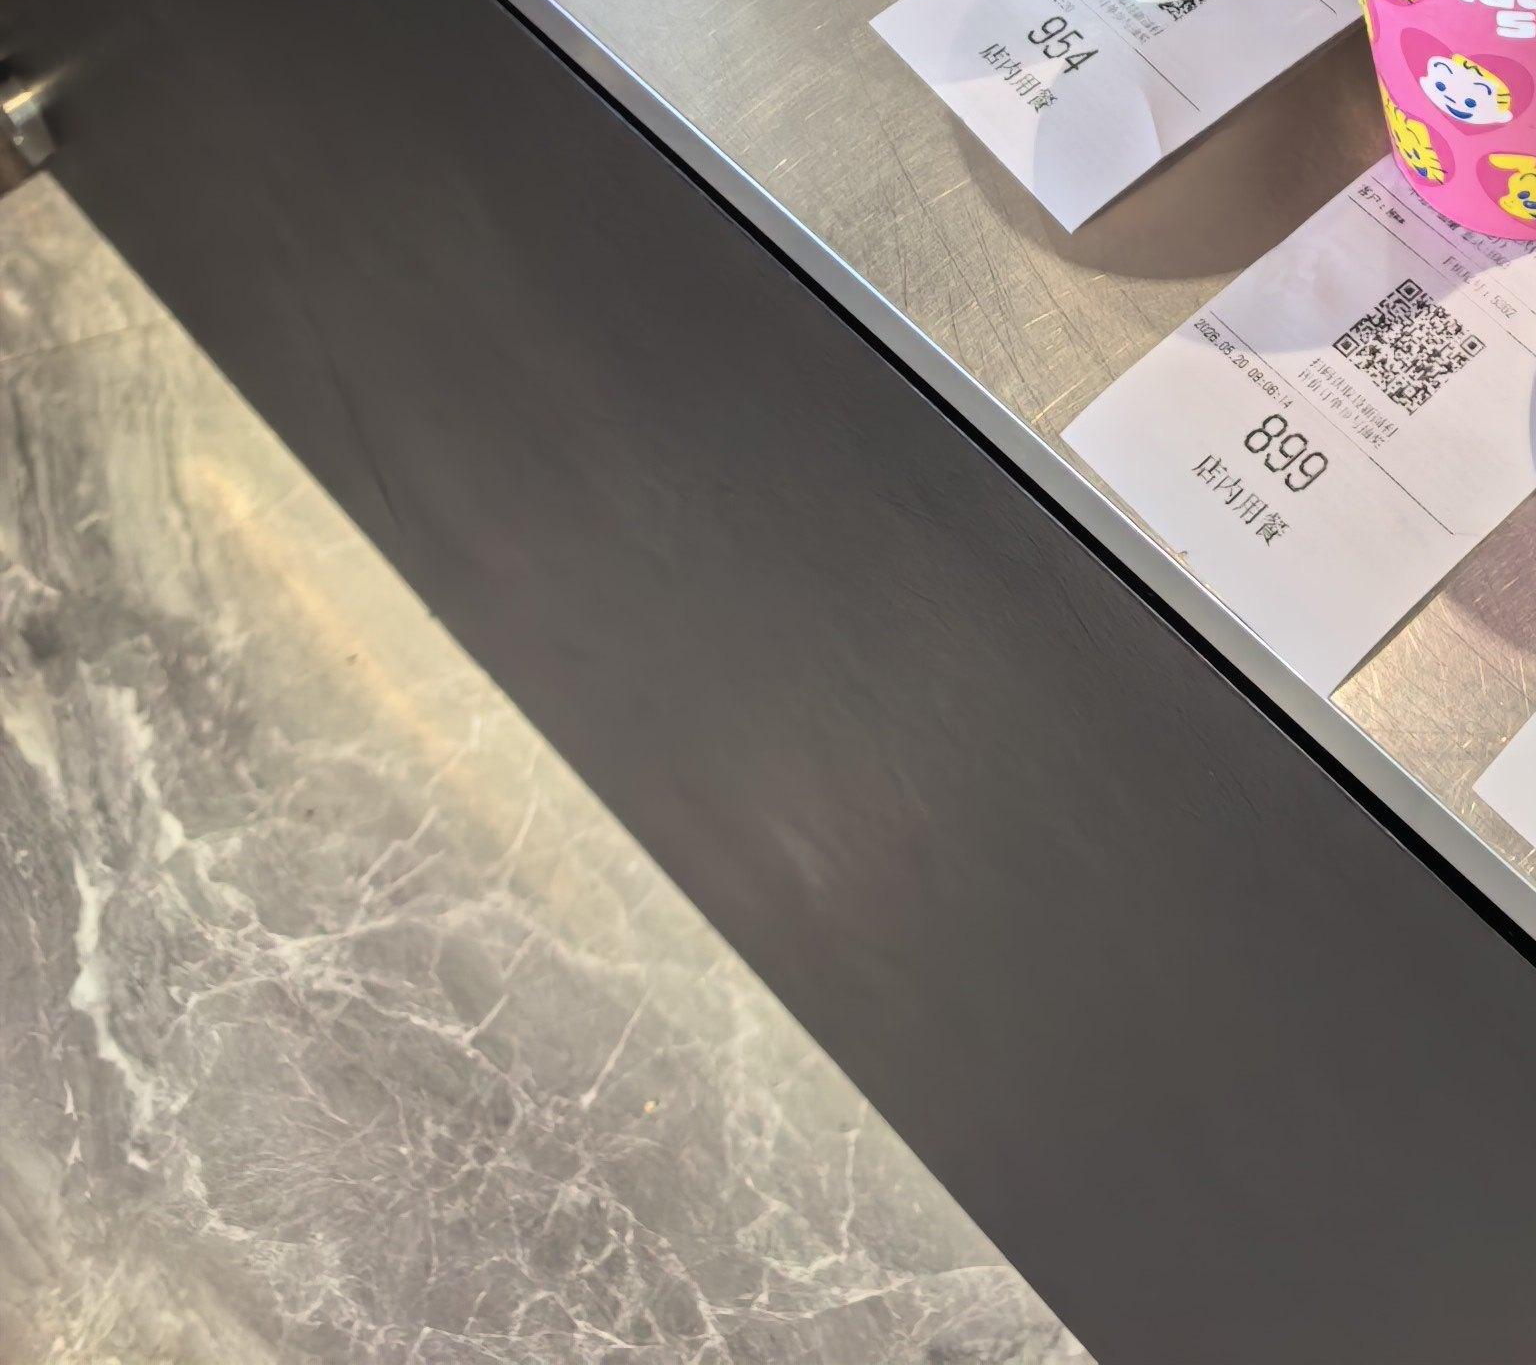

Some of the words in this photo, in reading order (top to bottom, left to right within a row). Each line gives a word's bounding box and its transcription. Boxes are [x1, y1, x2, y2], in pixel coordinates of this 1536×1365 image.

[1027, 13, 1099, 74] 954
[980, 46, 1057, 112] 店内用餐
[1192, 316, 1250, 371] 2026.05.20
[1238, 407, 1334, 498] 899
[1190, 457, 1291, 547] 店内用餐
